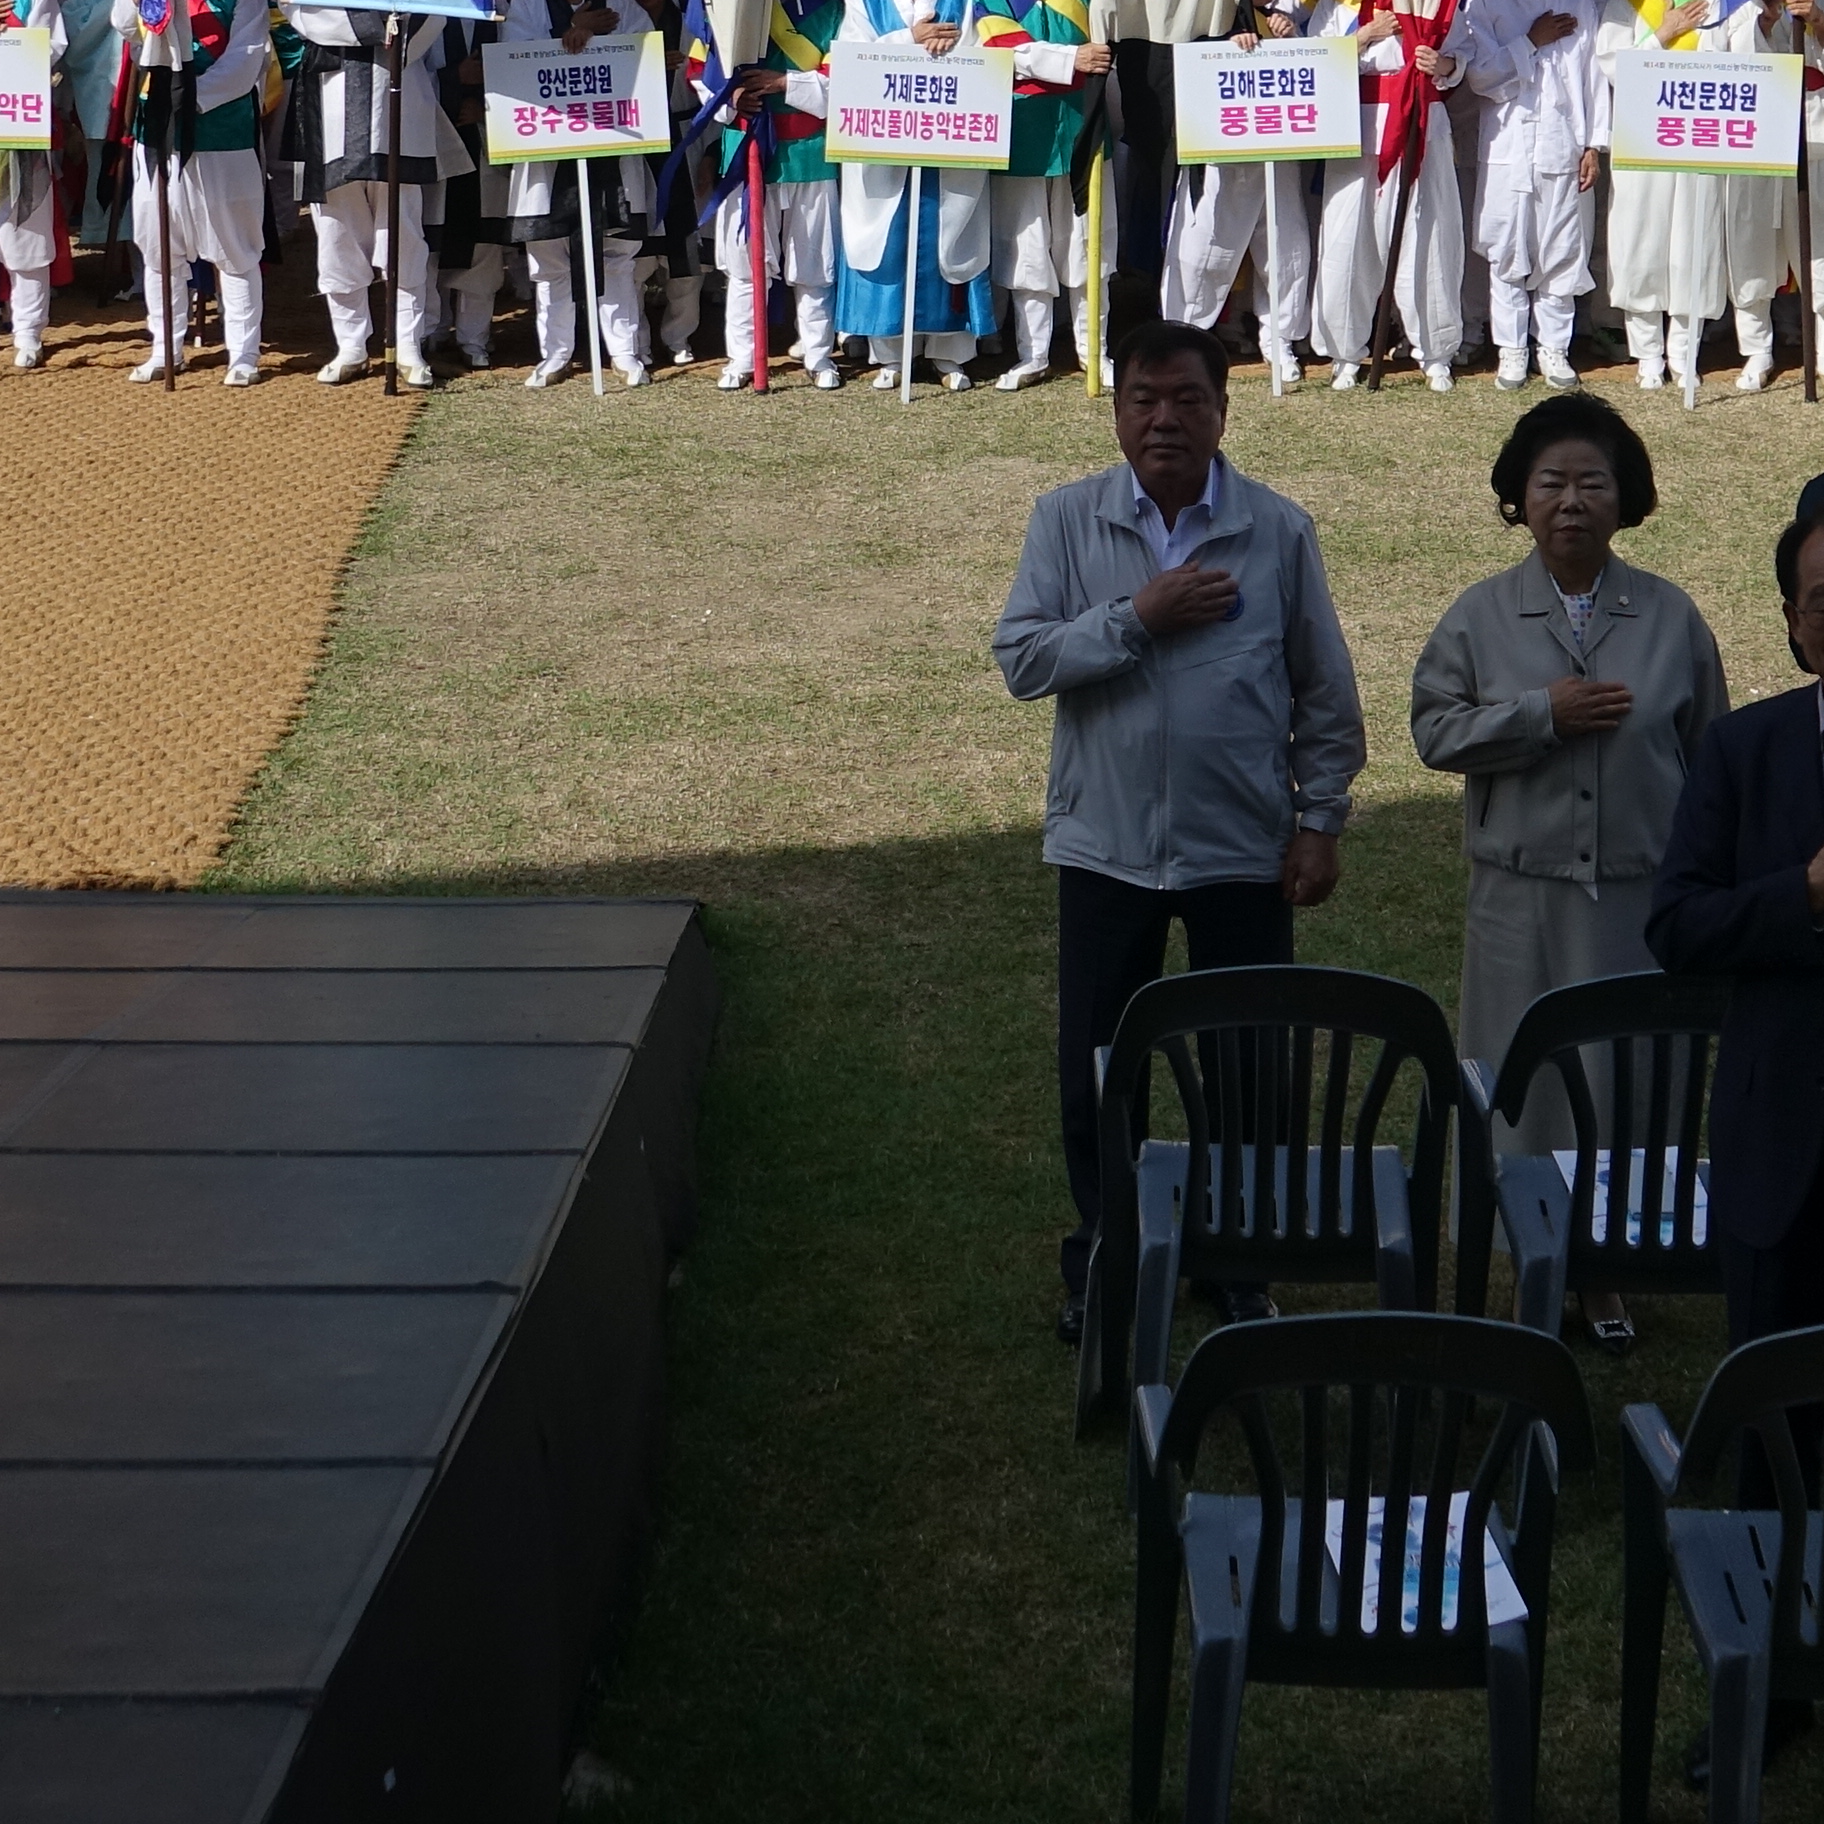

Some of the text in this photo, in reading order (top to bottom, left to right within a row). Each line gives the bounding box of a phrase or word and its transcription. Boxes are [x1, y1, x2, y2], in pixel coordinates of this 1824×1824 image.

[537, 64, 613, 99] 양산문화원
[1217, 67, 1316, 100] 김해문화원
[1643, 61, 1774, 73] 제14회 경상남도지사기 어르신농악경연대회
[883, 73, 958, 105] 거제문화원
[1656, 79, 1758, 112] 사천문화원
[513, 98, 641, 137] 장수풍물패
[838, 107, 999, 143] 거제진풀이농악보존회
[1219, 103, 1319, 137] 풍물단
[1656, 116, 1758, 149] 풍물단
